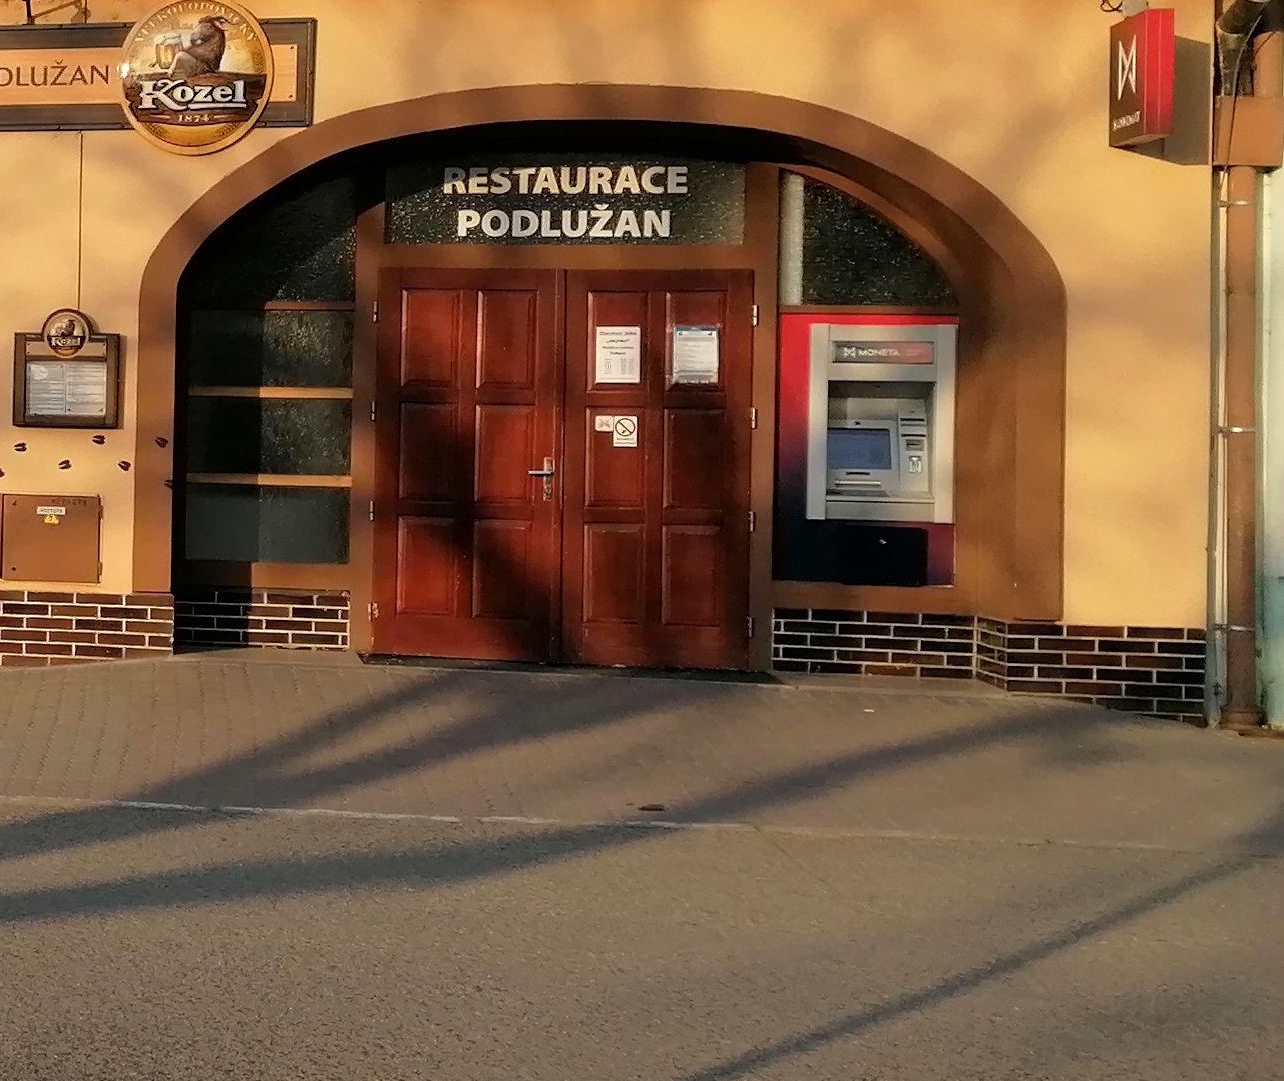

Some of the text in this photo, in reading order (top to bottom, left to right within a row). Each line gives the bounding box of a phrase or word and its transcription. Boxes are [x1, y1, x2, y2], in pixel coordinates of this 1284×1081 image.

[137, 79, 247, 111] Kozel
[177, 114, 211, 123] 1874
[442, 166, 689, 195] RESTAURACE
[456, 204, 672, 238] PODLUŽAN
[857, 348, 901, 357] MONETA
